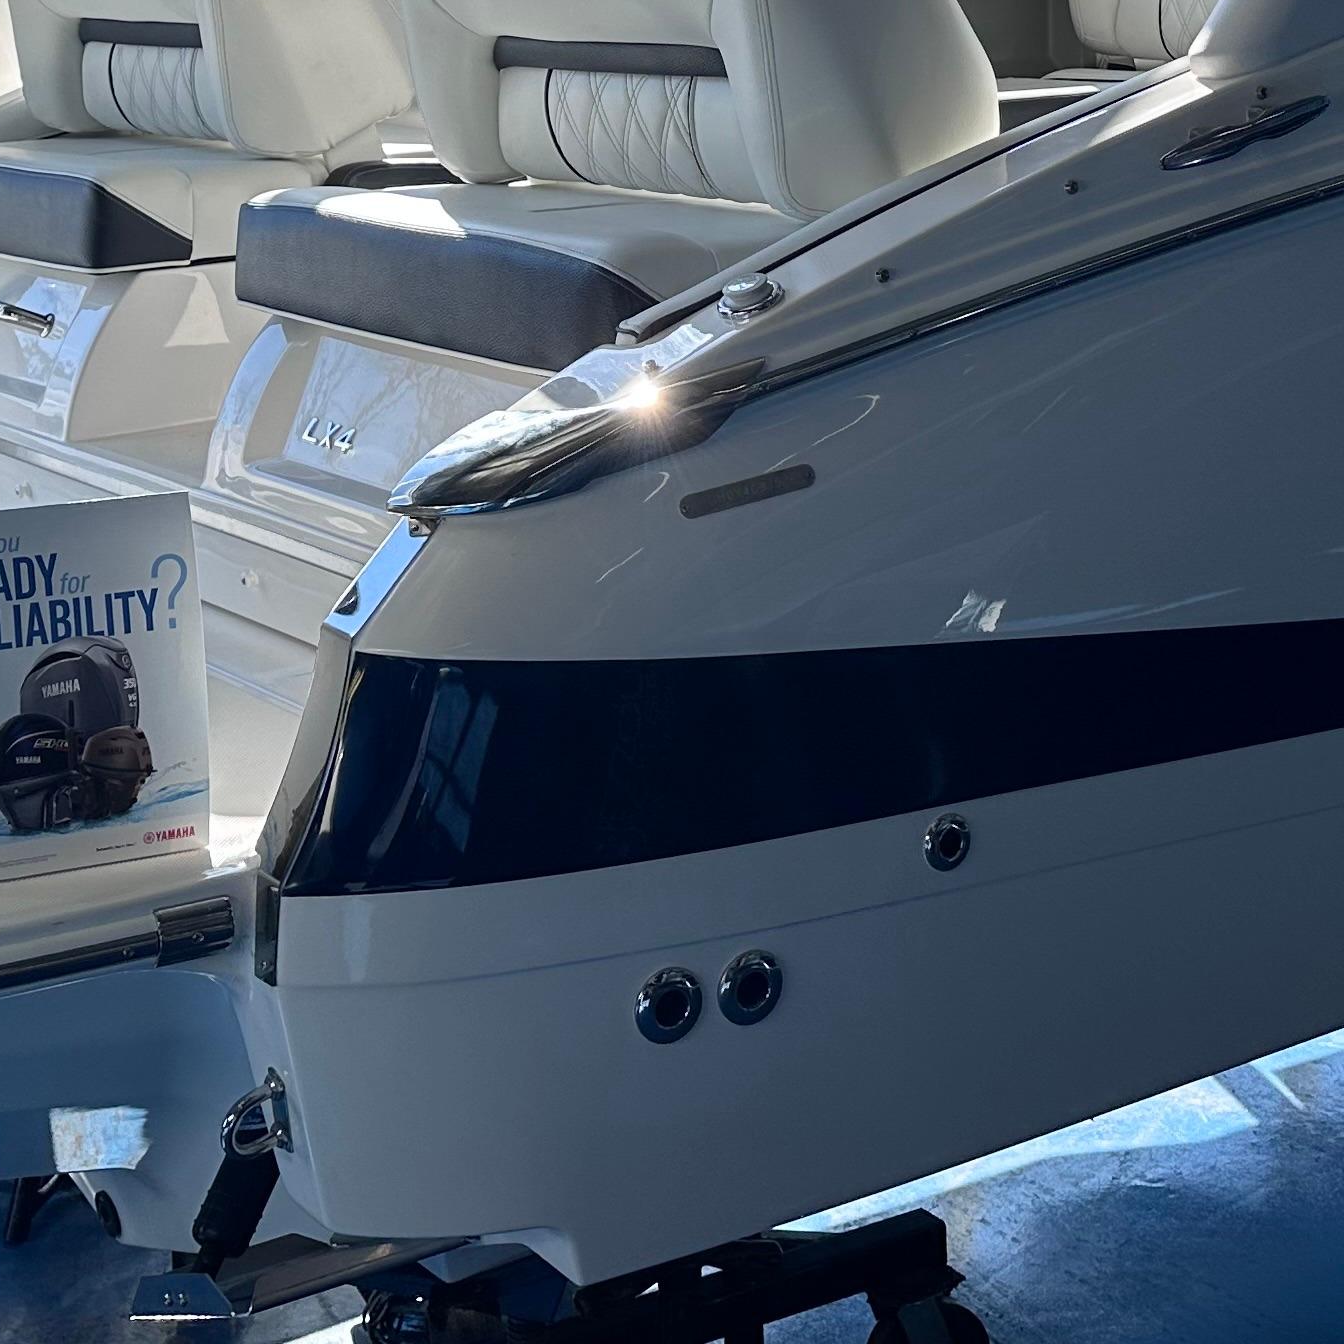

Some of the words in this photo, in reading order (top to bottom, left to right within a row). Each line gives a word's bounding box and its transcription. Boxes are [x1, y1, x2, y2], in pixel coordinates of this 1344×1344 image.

[301, 417, 356, 455] LX4
[59, 572, 90, 595] for
[41, 678, 81, 699] YAMAHA
[155, 825, 196, 843] YAMAHA
